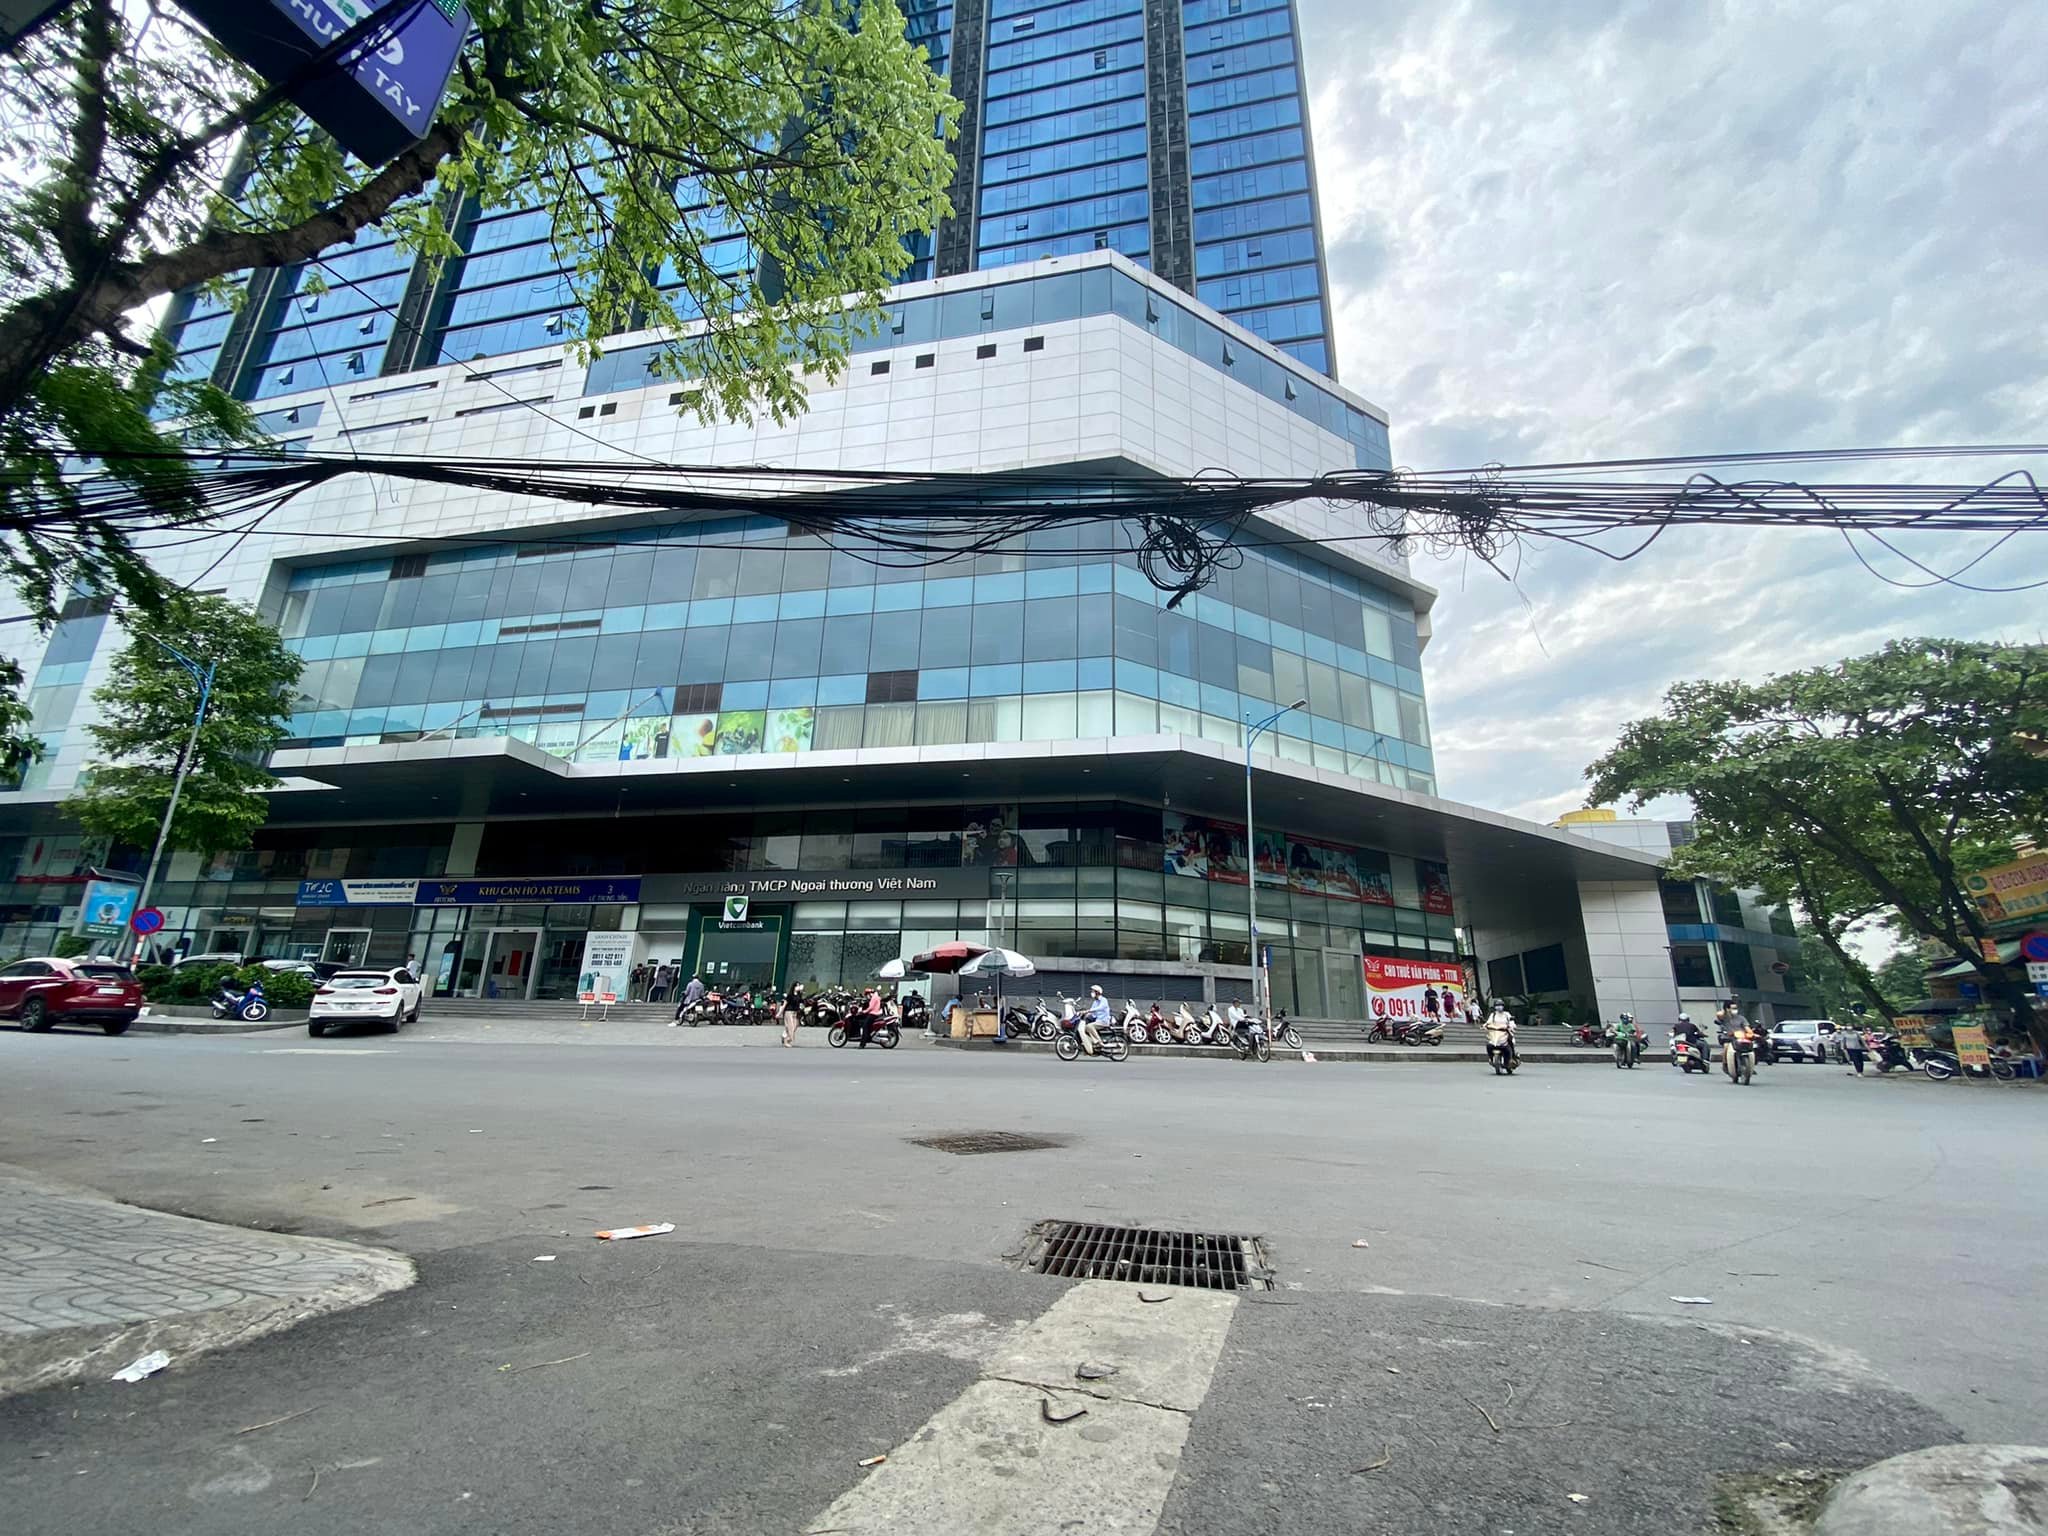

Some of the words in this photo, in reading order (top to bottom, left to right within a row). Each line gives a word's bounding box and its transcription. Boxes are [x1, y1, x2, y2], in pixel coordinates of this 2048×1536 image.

[479, 887, 499, 896] KHU
[538, 886, 581, 896] ARTEMIS
[750, 880, 787, 892] TMCP
[791, 879, 826, 893] Ngoại
[830, 879, 873, 892] thương
[878, 877, 903, 890] Việt
[906, 878, 937, 889] Nam
[1384, 964, 1396, 977] CHO
[1388, 998, 1416, 1017] 0911
